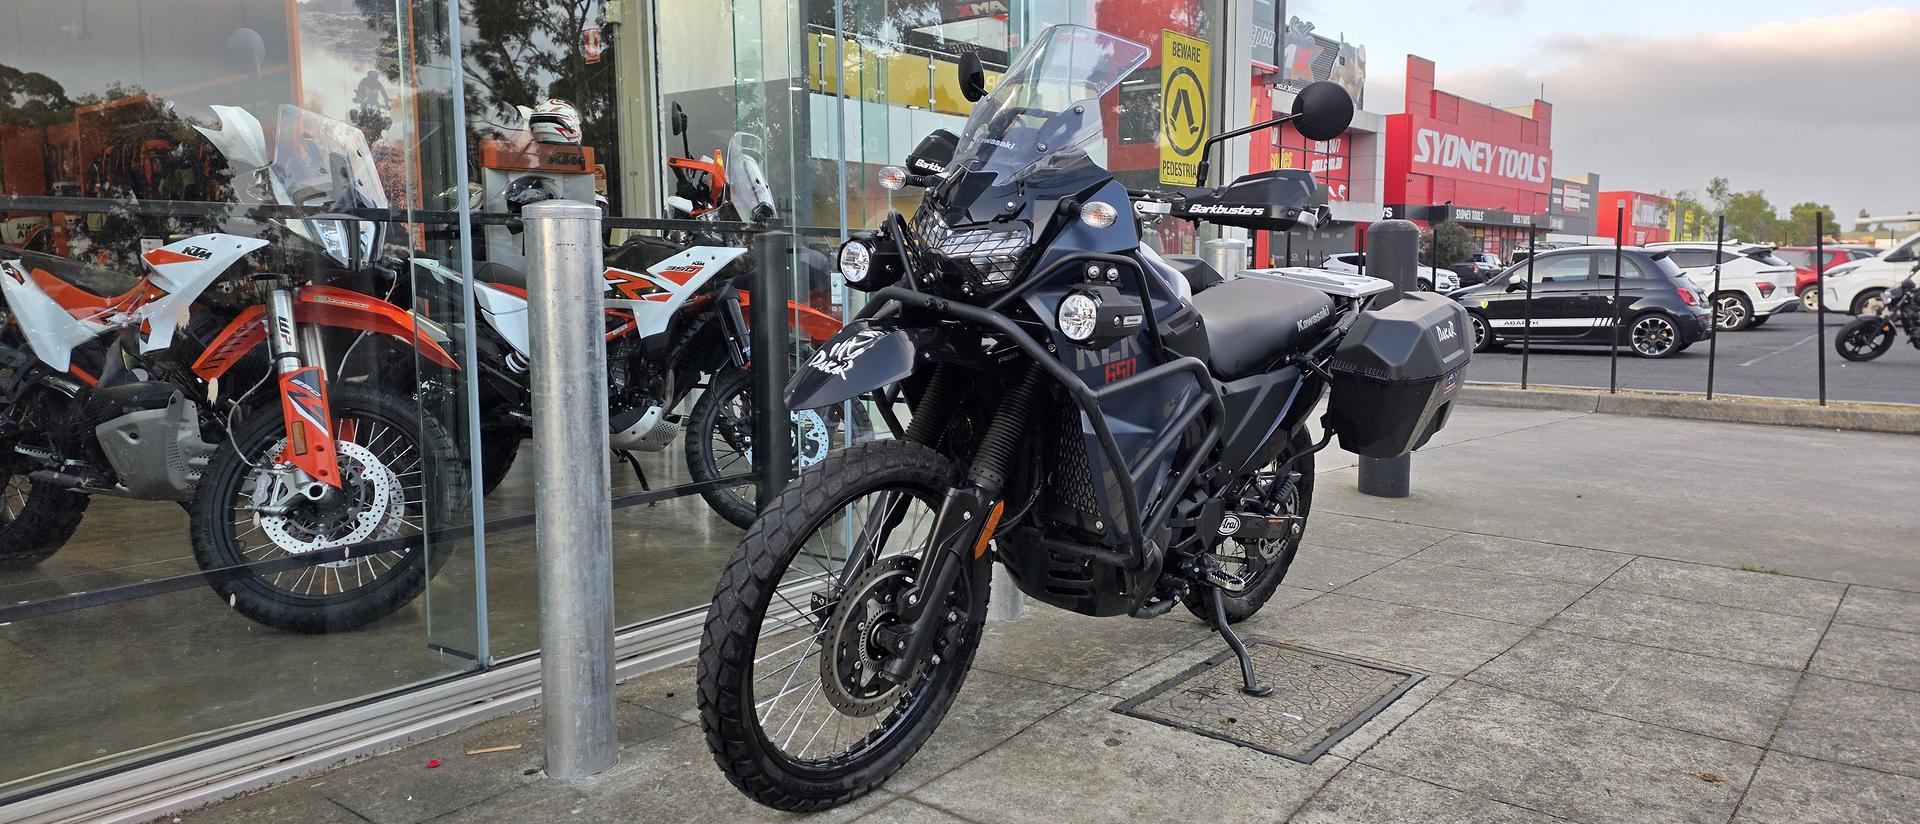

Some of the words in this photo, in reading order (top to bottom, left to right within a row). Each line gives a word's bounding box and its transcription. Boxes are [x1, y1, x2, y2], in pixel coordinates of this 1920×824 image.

[1171, 41, 1201, 63] BEWARE
[1413, 127, 1498, 174] SYDNEY
[1498, 145, 1548, 184] TOOLS
[1188, 203, 1265, 216] Barkbusters
[181, 245, 213, 260] KTM
[1296, 304, 1330, 333] Kawasaki
